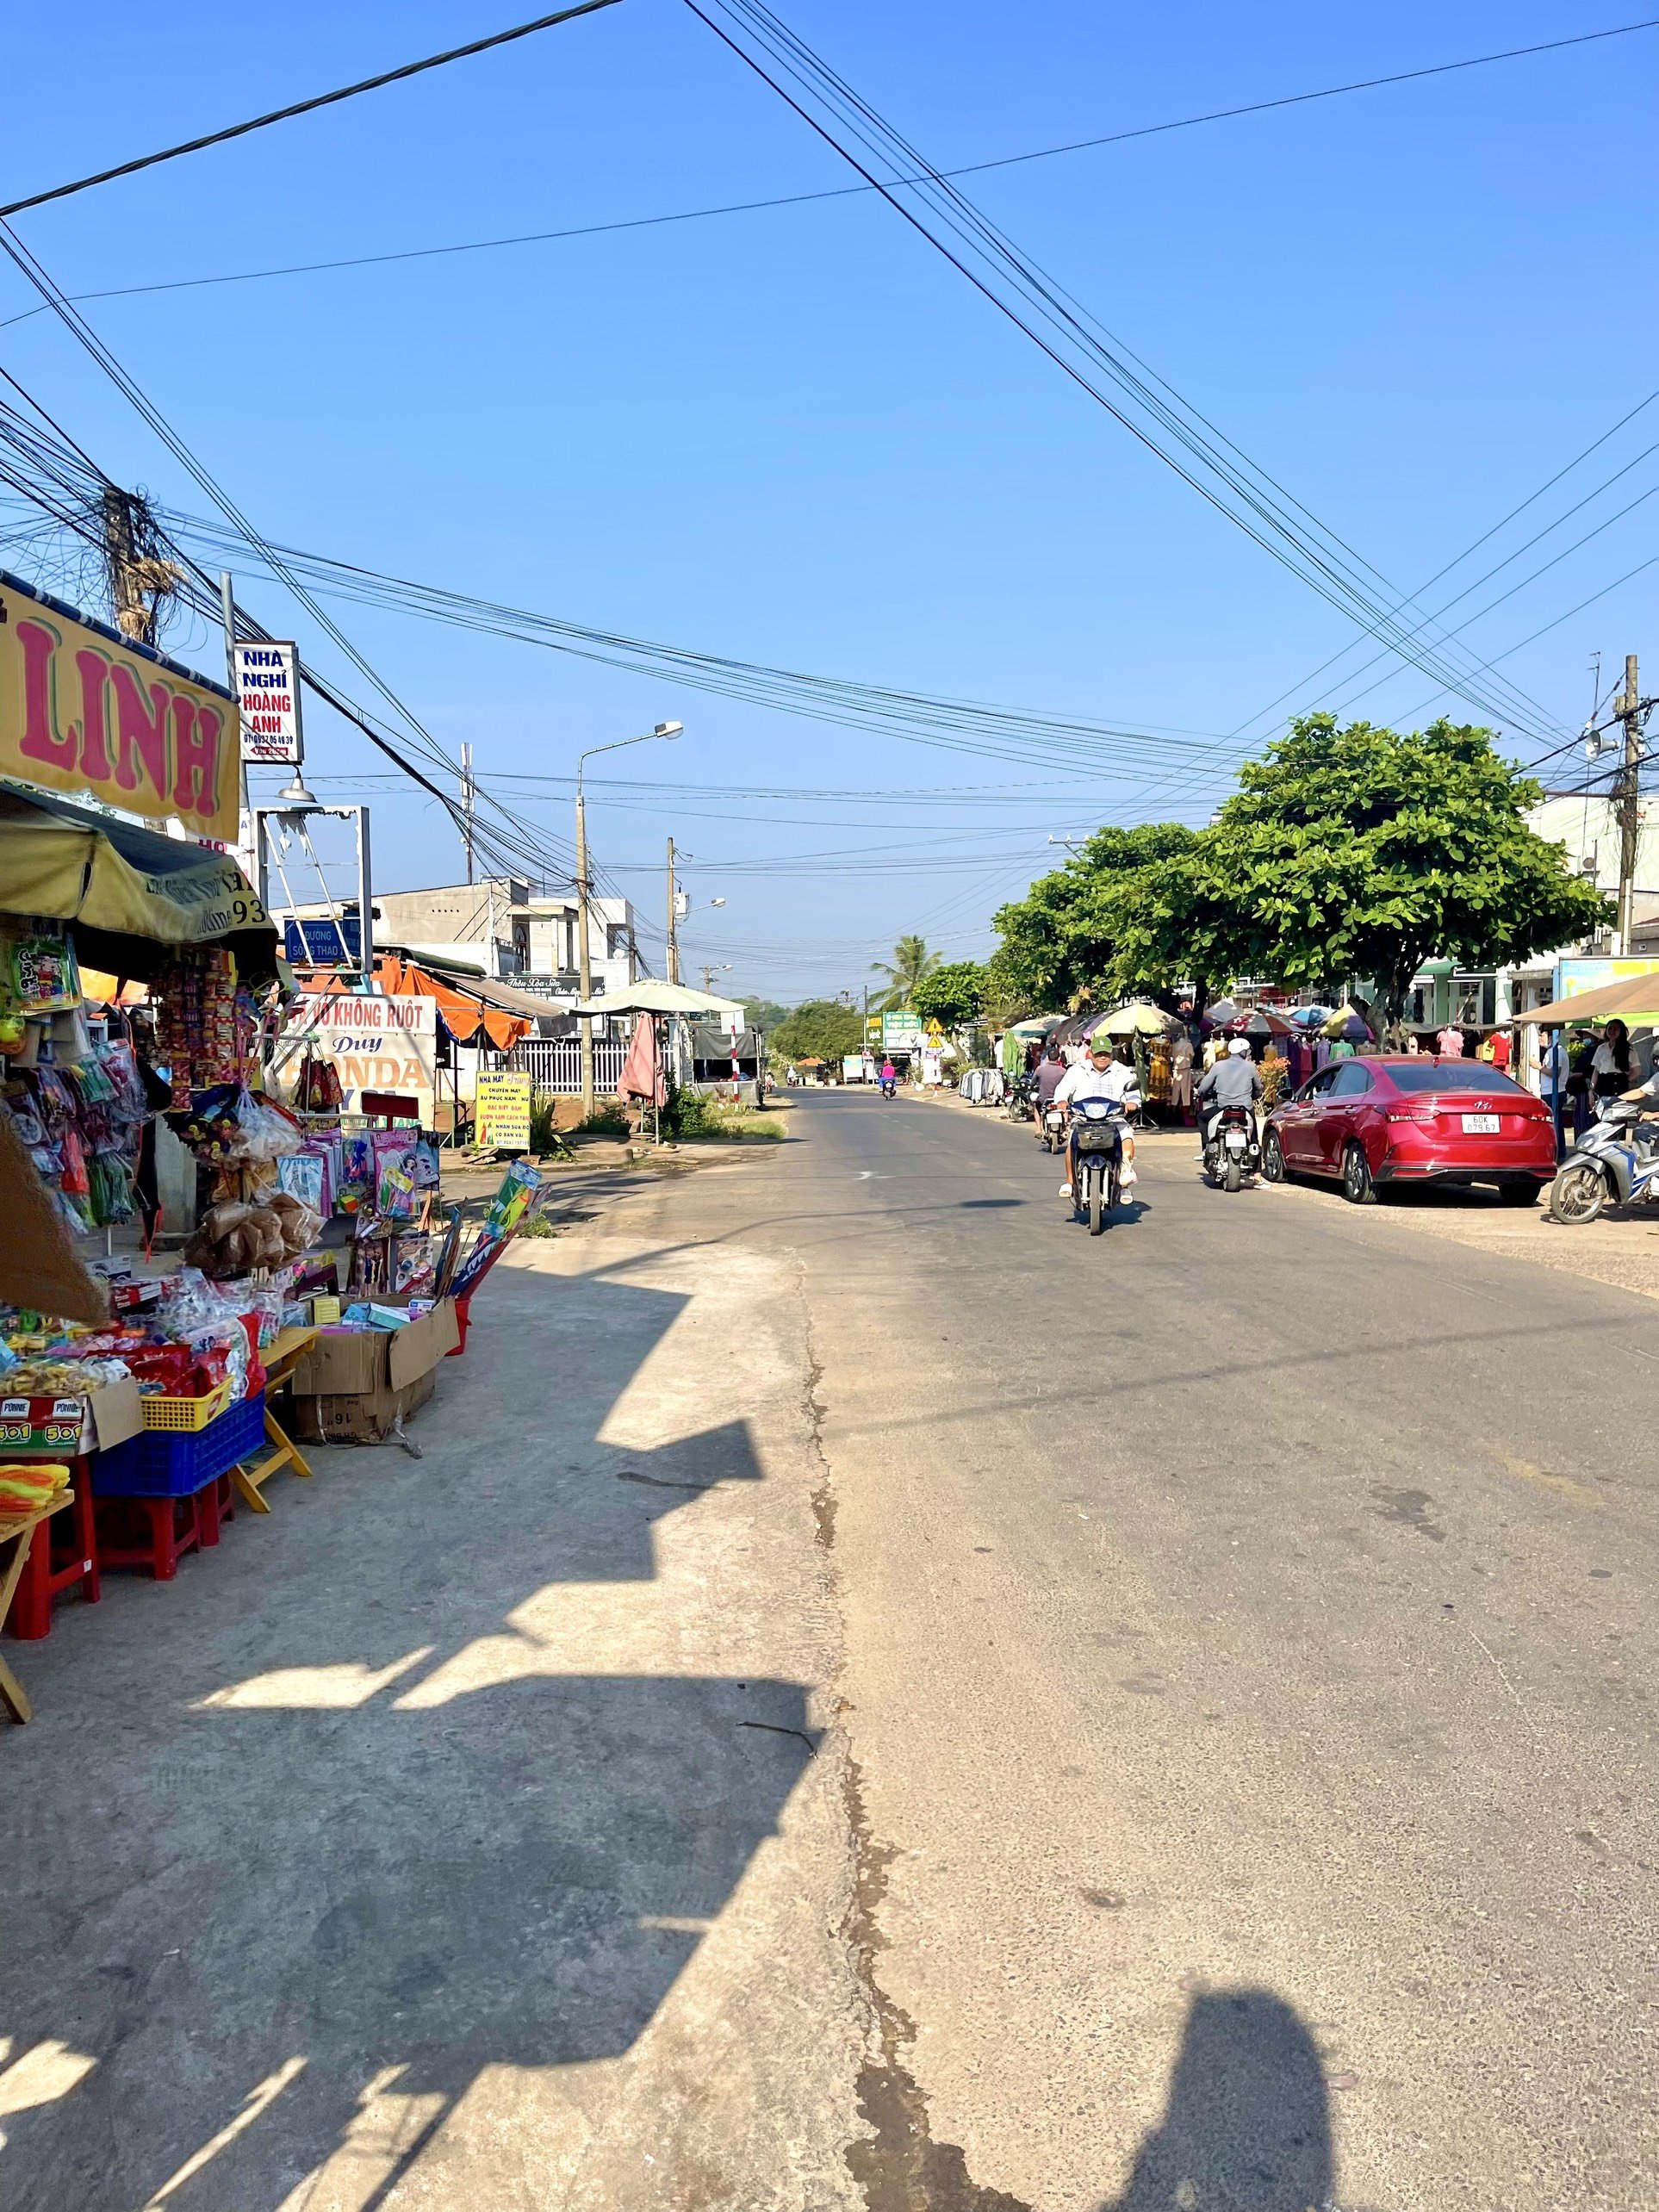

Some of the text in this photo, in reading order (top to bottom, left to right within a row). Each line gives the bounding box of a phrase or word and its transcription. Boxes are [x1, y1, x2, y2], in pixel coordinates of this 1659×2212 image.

[243, 649, 284, 667] NHÀ
[243, 691, 291, 712] HOÀNG
[16, 618, 226, 818] LINH
[252, 715, 282, 733] ANH
[305, 927, 332, 941] ĐƯỜNG
[293, 943, 314, 956] SÔG
[315, 945, 339, 956] THAO
[333, 997, 382, 1028] KHÔNG
[386, 999, 423, 1032] RUỘT
